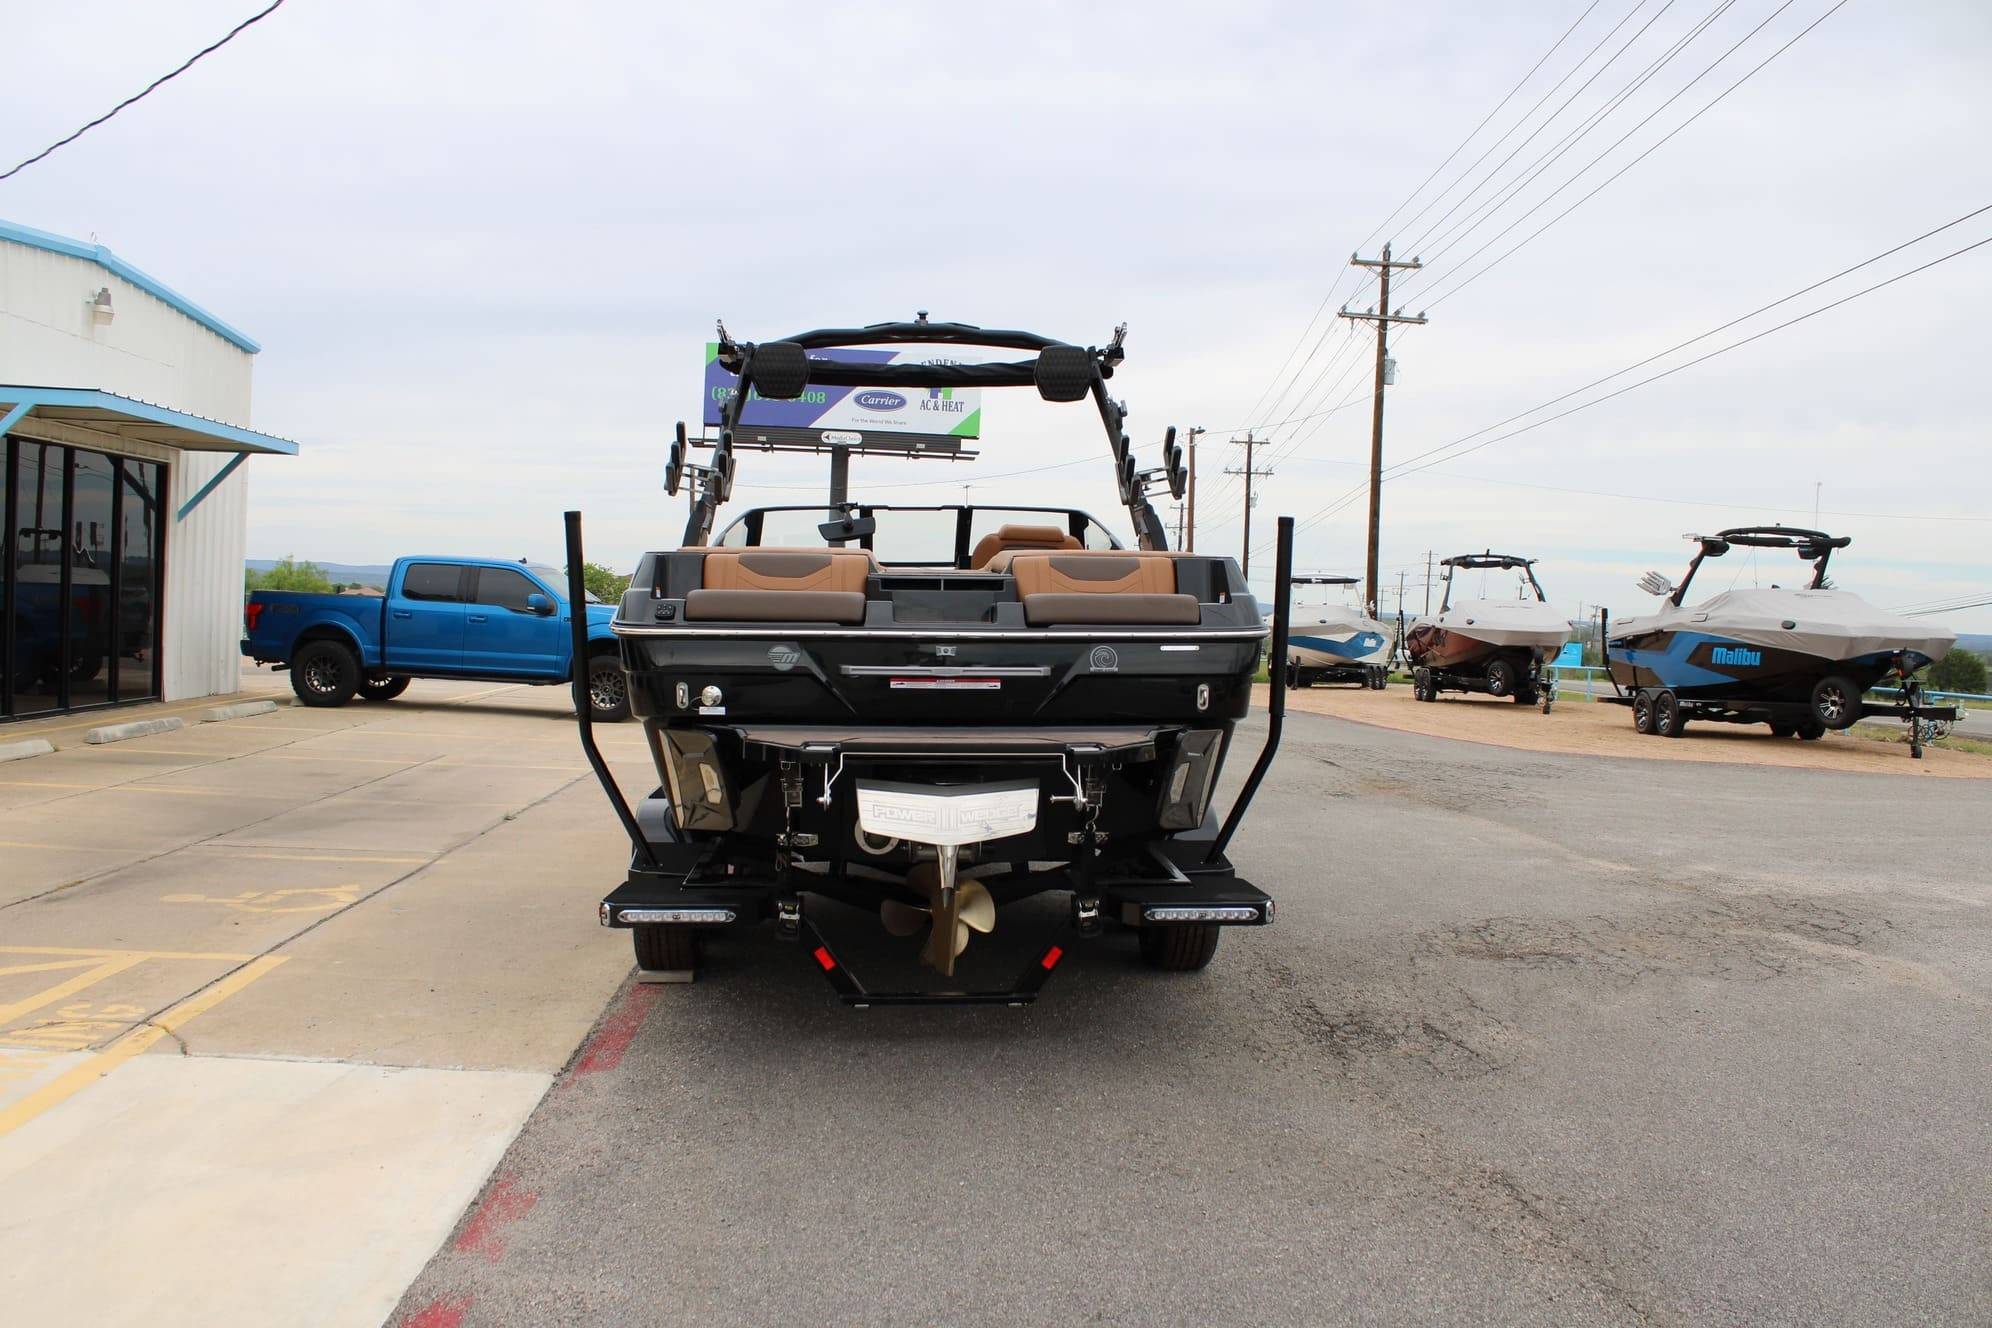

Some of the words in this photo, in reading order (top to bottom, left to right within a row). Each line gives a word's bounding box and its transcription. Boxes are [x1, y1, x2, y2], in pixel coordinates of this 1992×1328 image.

[861, 394, 900, 406] Carrier
[920, 399, 931, 411] AC
[932, 400, 940, 411] &
[941, 400, 965, 412] HEAT
[1712, 647, 1760, 665] Malibu
[873, 804, 936, 824] POWER
